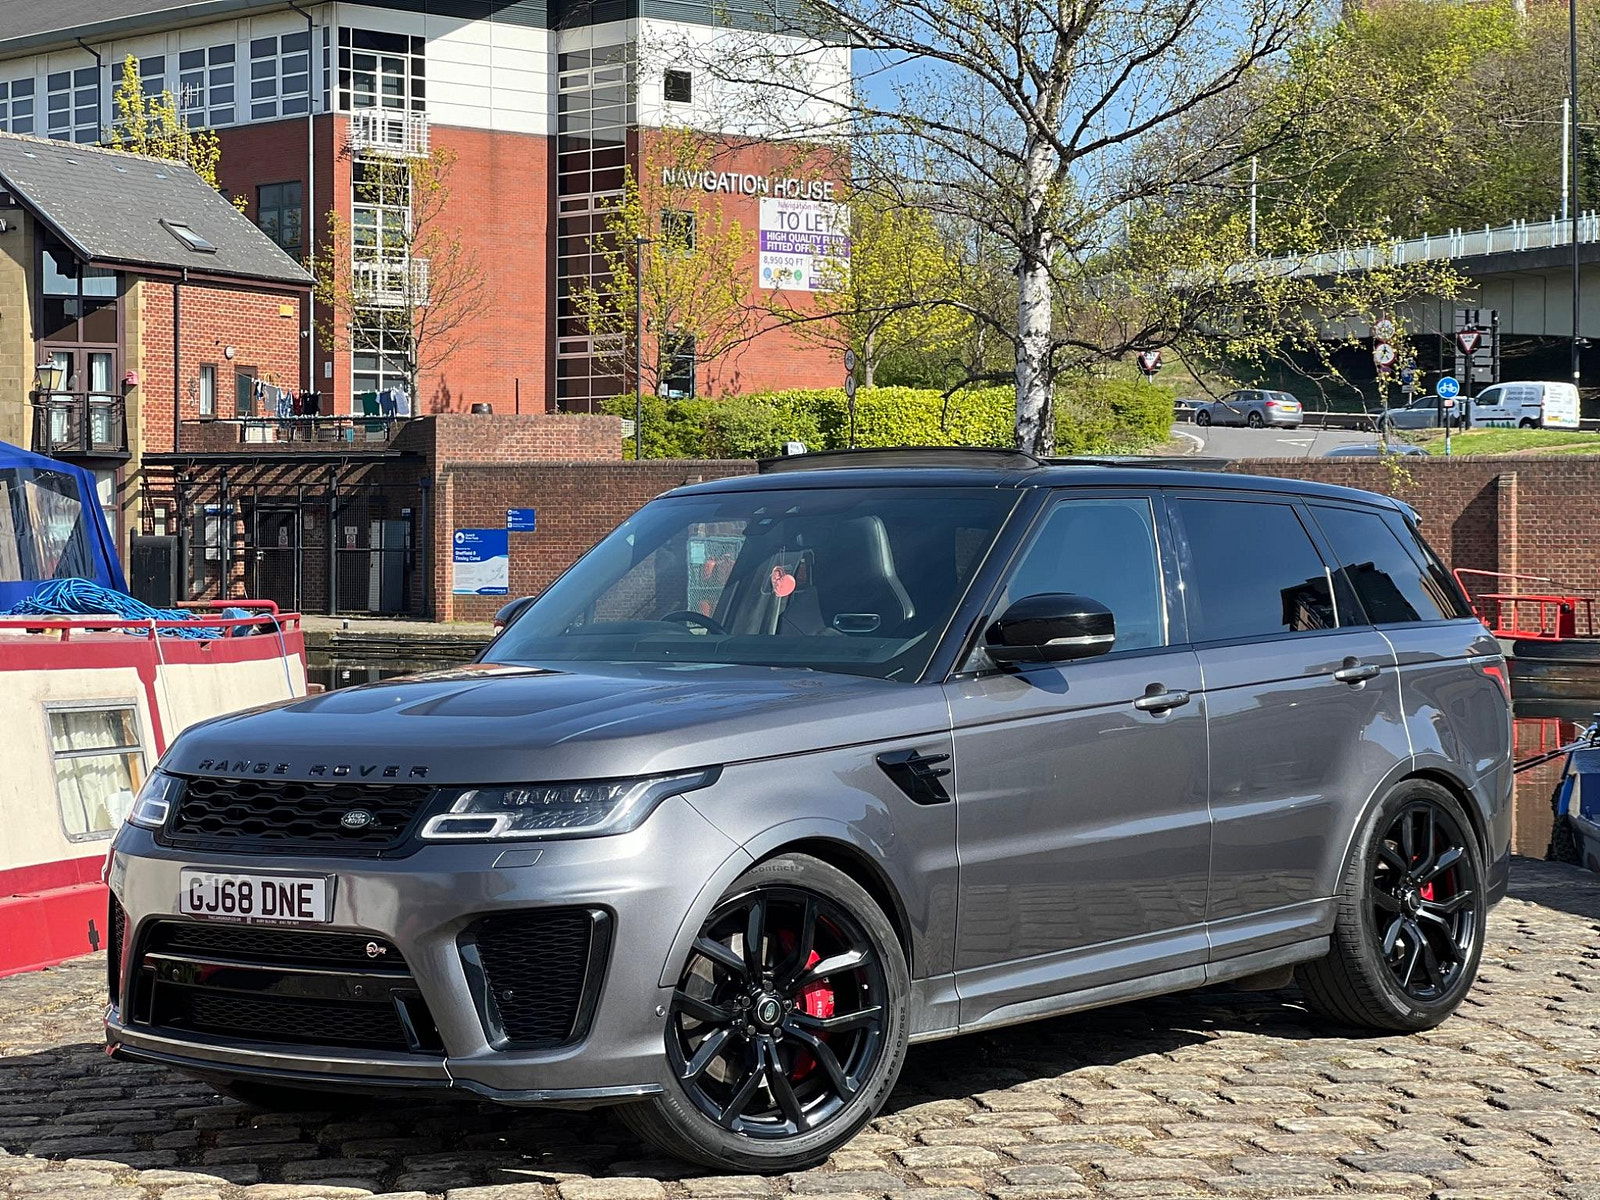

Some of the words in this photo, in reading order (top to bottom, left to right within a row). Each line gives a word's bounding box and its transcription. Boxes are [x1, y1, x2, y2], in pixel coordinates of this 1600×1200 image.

[662, 166, 769, 195] NAVIGATION
[774, 177, 835, 200] HOUSE
[777, 211, 800, 230] TO
[806, 213, 833, 233] LET
[766, 232, 788, 241] HIGH
[788, 233, 821, 244] QUALITY
[766, 241, 793, 251] FITTED
[763, 255, 783, 265] 8,950
[784, 257, 794, 267] SQ
[796, 258, 803, 266] FT
[199, 758, 291, 775] RANGE
[309, 764, 430, 779] ROVER
[189, 877, 253, 914] GJ68
[261, 881, 314, 918] DNE
